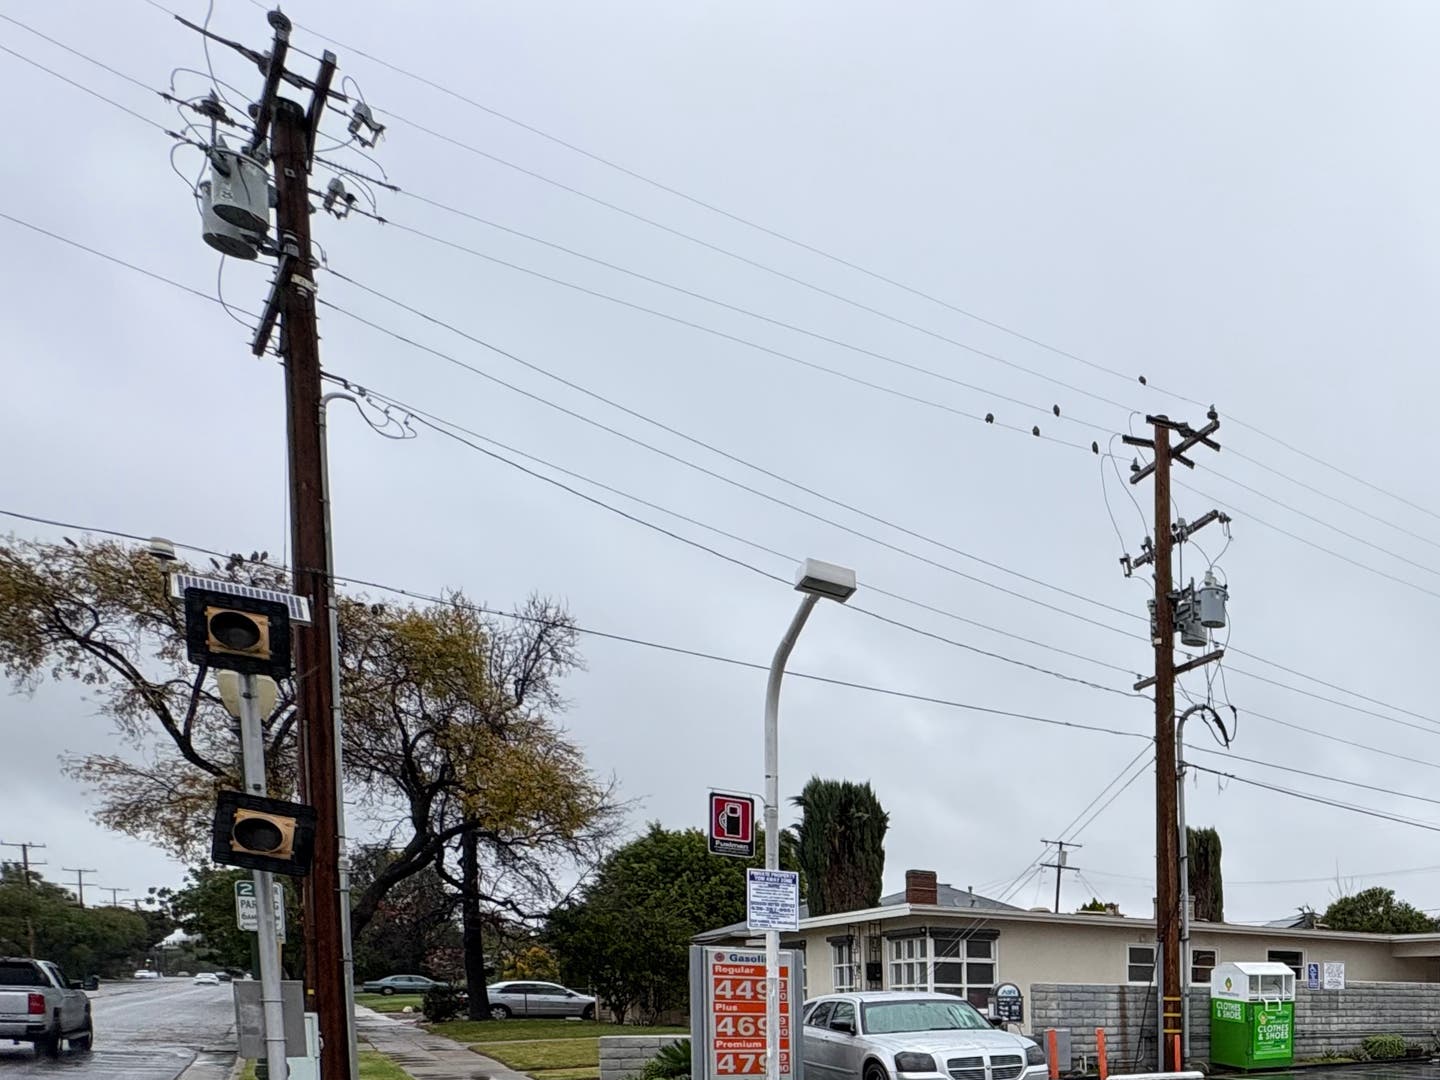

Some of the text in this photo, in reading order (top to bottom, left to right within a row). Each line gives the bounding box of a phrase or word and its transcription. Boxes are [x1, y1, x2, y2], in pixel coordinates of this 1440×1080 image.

[240, 883, 253, 895] 2
[714, 965, 755, 975] Regular
[715, 1003, 738, 1011] Plus
[1258, 1024, 1289, 1033] CLOTHES
[1266, 1031, 1289, 1040] SHOES
[716, 1040, 763, 1048] Premium
